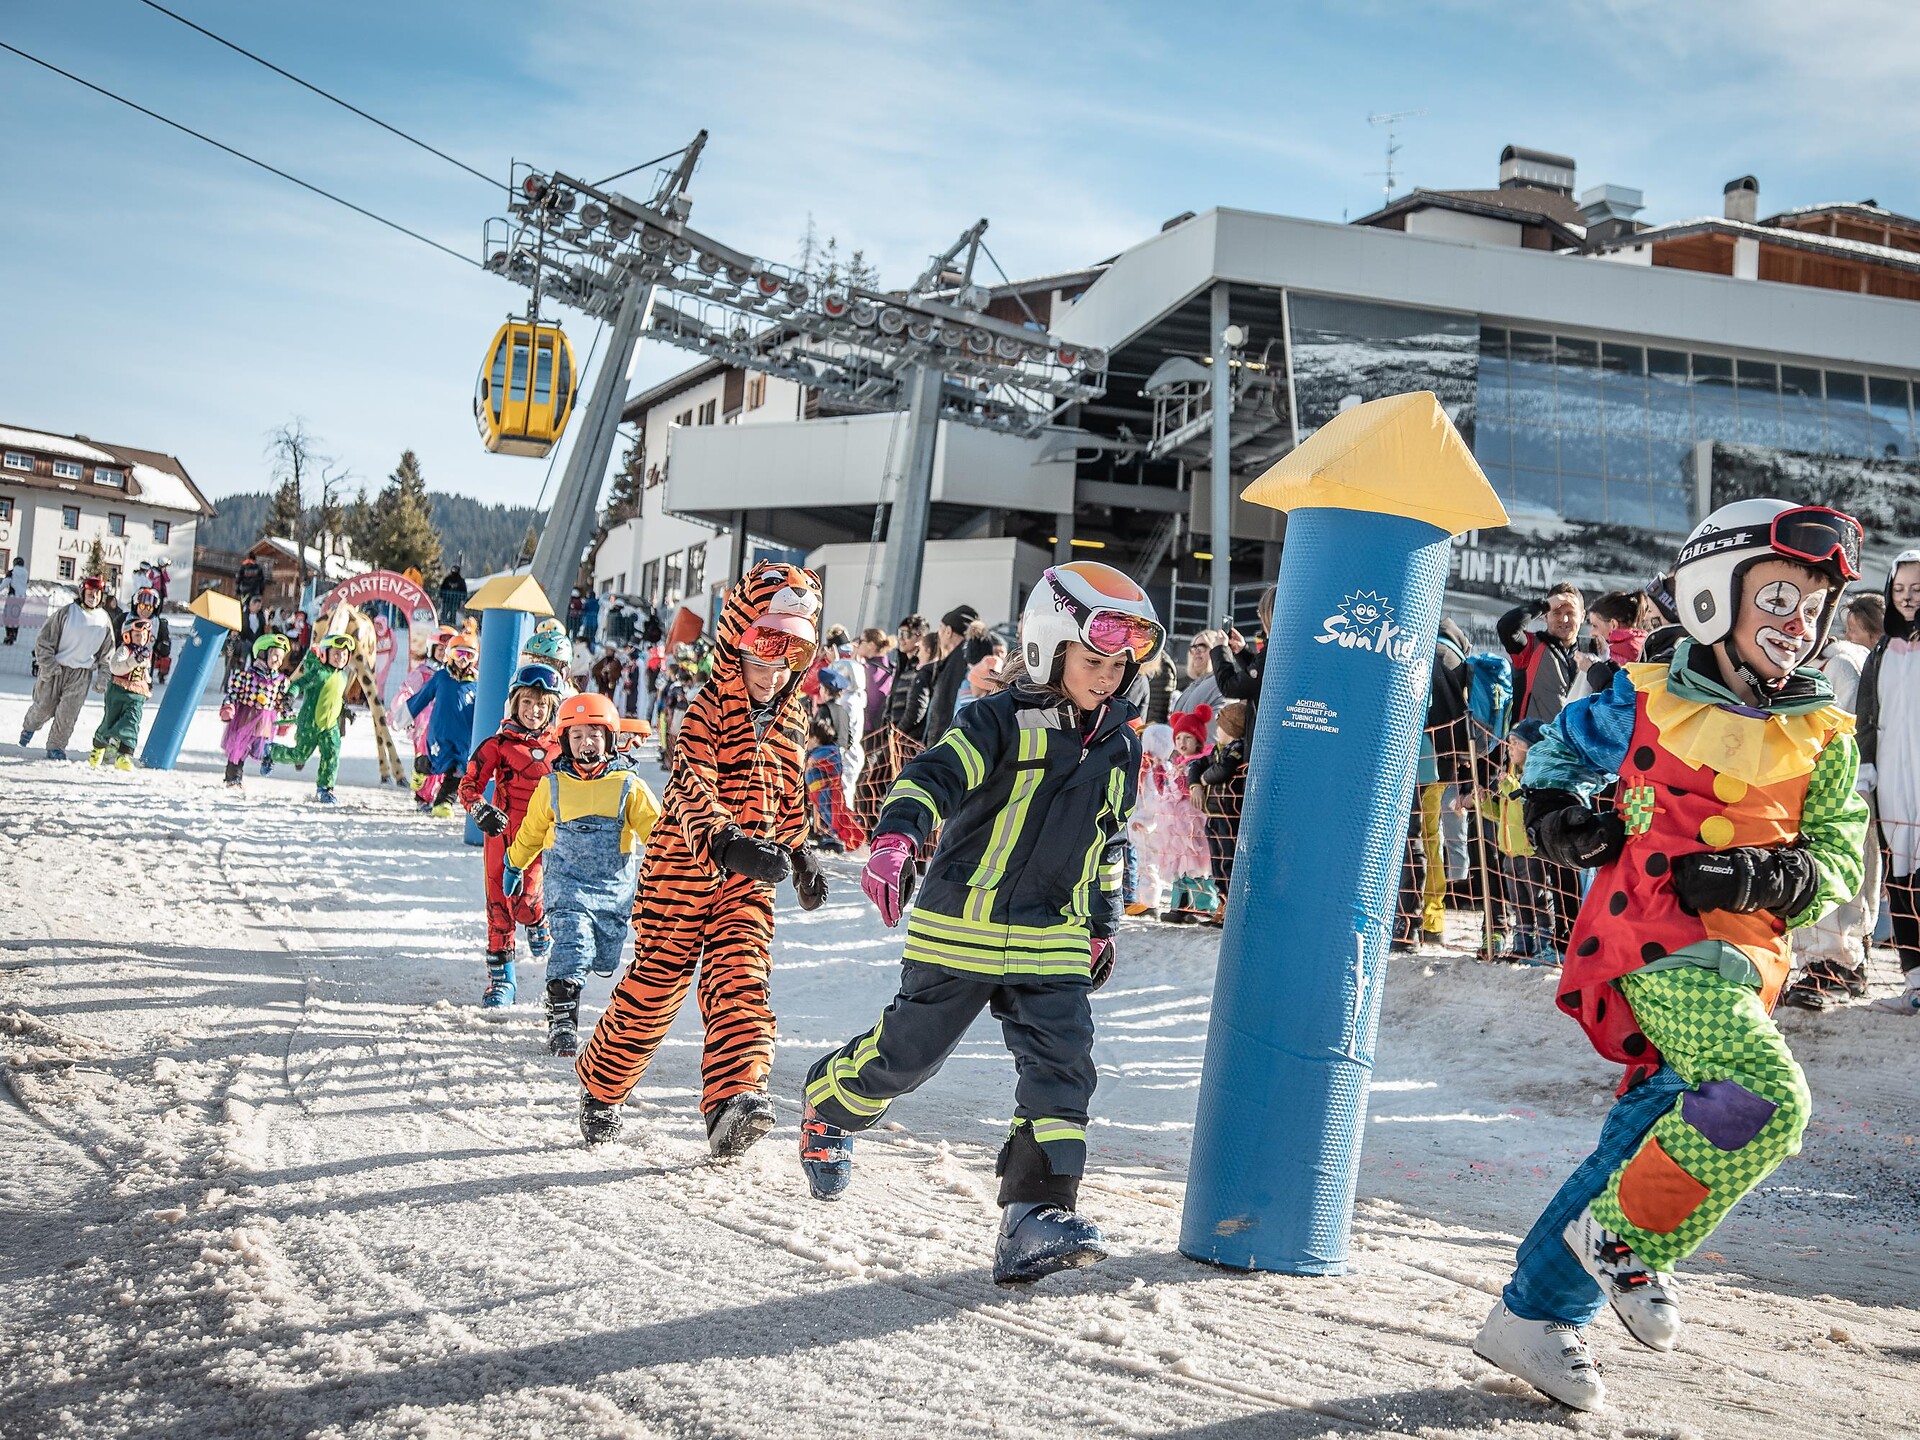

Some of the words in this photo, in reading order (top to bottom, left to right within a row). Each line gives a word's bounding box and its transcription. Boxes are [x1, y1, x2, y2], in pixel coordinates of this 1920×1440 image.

[58, 536, 123, 559] LADNIA
[1460, 548, 1488, 583] IN
[1493, 551, 1558, 590] ITALY
[337, 576, 422, 607] PARTENZA
[1286, 705, 1323, 716] UNGEEIGNET
[1323, 709, 1338, 718] FÜR
[1295, 699, 1328, 709] ACHTUNG:
[1291, 713, 1313, 722] TUBING
[1314, 716, 1328, 724] UND
[1580, 842, 1609, 860] reusch
[1699, 864, 1734, 875] reusch
